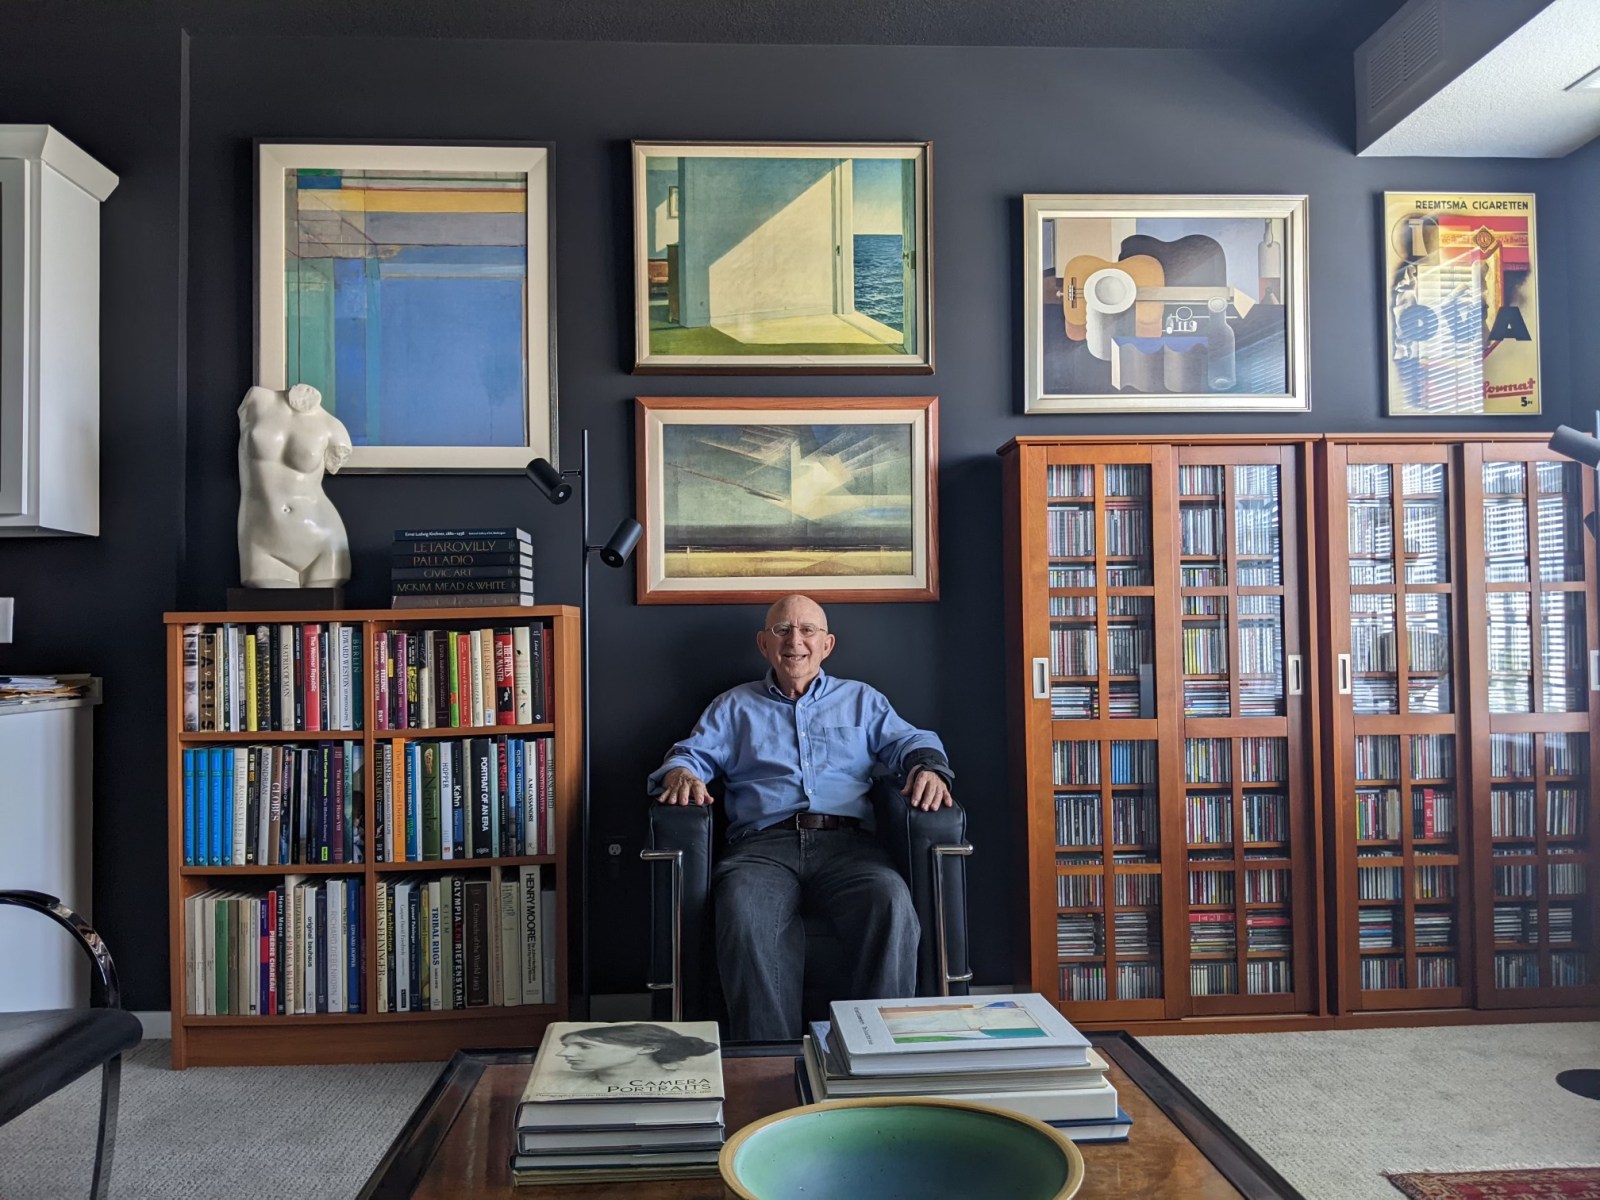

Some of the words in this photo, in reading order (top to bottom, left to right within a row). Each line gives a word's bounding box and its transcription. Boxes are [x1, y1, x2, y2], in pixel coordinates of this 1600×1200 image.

[1415, 200, 1468, 210] REEMTSMA
[1472, 201, 1528, 210] CIGARETTEN
[413, 541, 496, 552] LETAROVILLY
[413, 555, 474, 566] PALLADIO
[424, 569, 450, 578] CIVIC
[454, 568, 472, 576] ART
[435, 582, 465, 591] MEAD
[476, 581, 506, 590] WHITE
[495, 641, 503, 658] MUSIC
[499, 765, 507, 792] Berlin
[272, 782, 280, 822] GLOBES
[423, 776, 438, 832] Netsuke
[481, 794, 488, 804] OF
[482, 805, 488, 816] AN
[526, 873, 535, 905] HENRY
[377, 885, 385, 926] ANDREAS
[527, 906, 536, 942] MOORE
[377, 928, 385, 976] FEININGER
[630, 1078, 710, 1086] CAMERA
[608, 1084, 711, 1093] PORTRAITS
